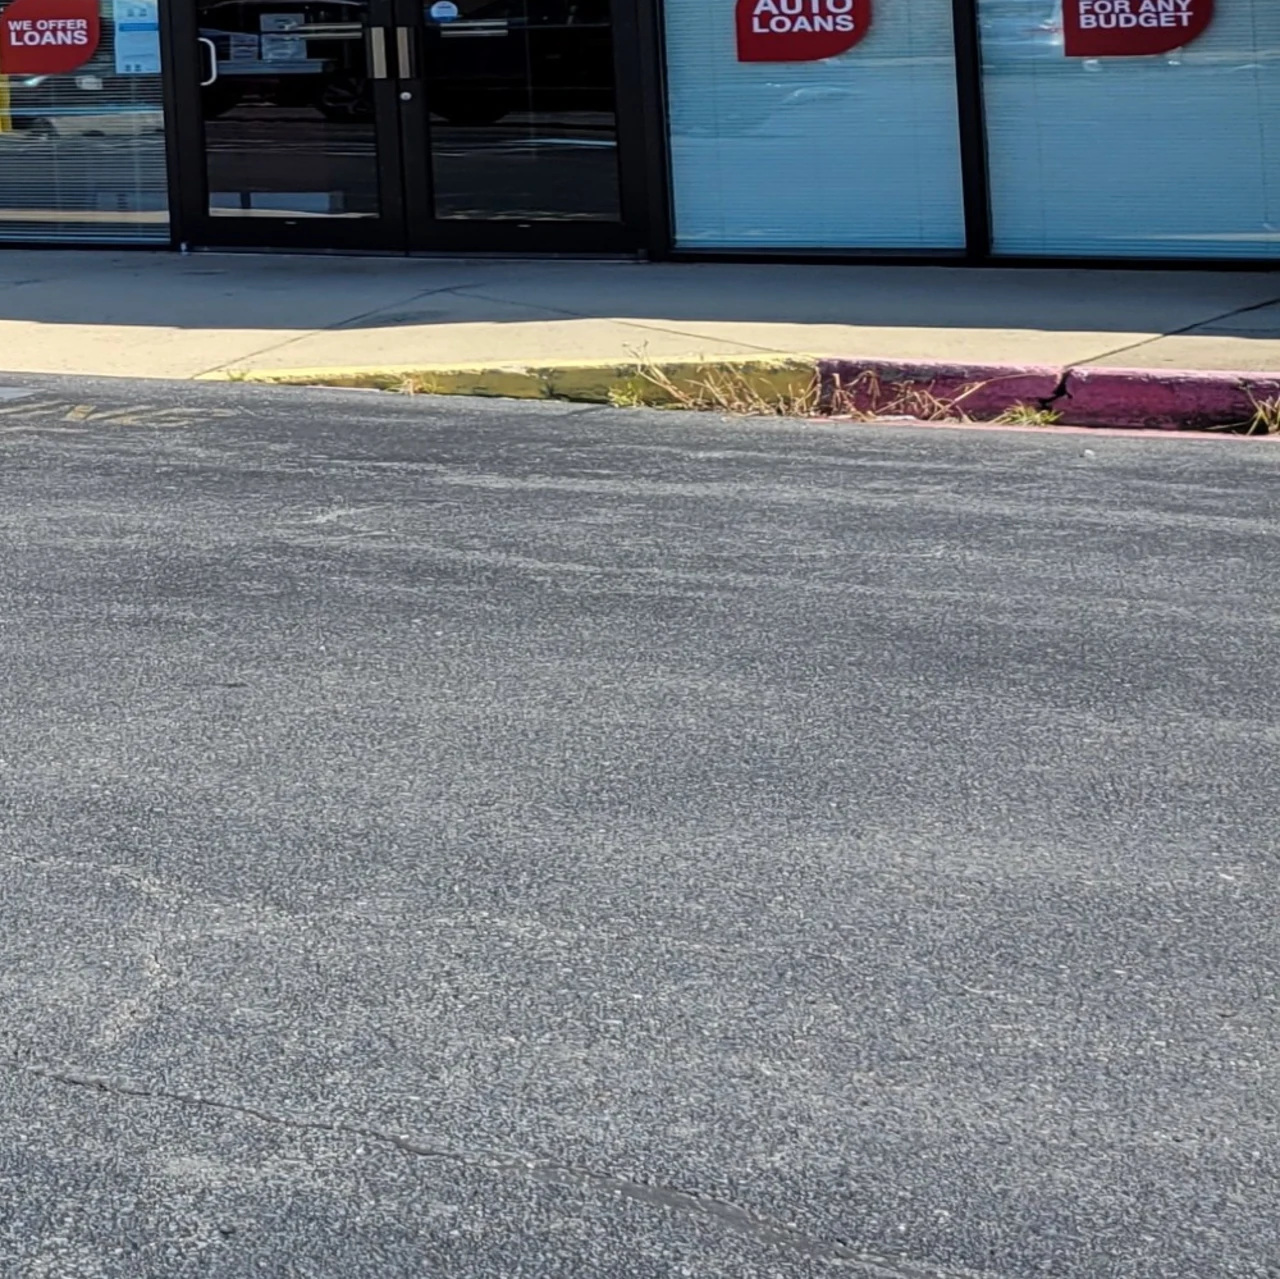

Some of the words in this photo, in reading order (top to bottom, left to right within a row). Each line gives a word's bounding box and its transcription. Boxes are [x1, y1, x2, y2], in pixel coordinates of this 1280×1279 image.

[1079, 0, 1131, 14] FOR
[8, 20, 33, 31] WE
[36, 19, 88, 30] OFFER
[752, 15, 855, 33] LOANS
[1079, 12, 1194, 29] BUDGET
[10, 30, 89, 46] LOANS
